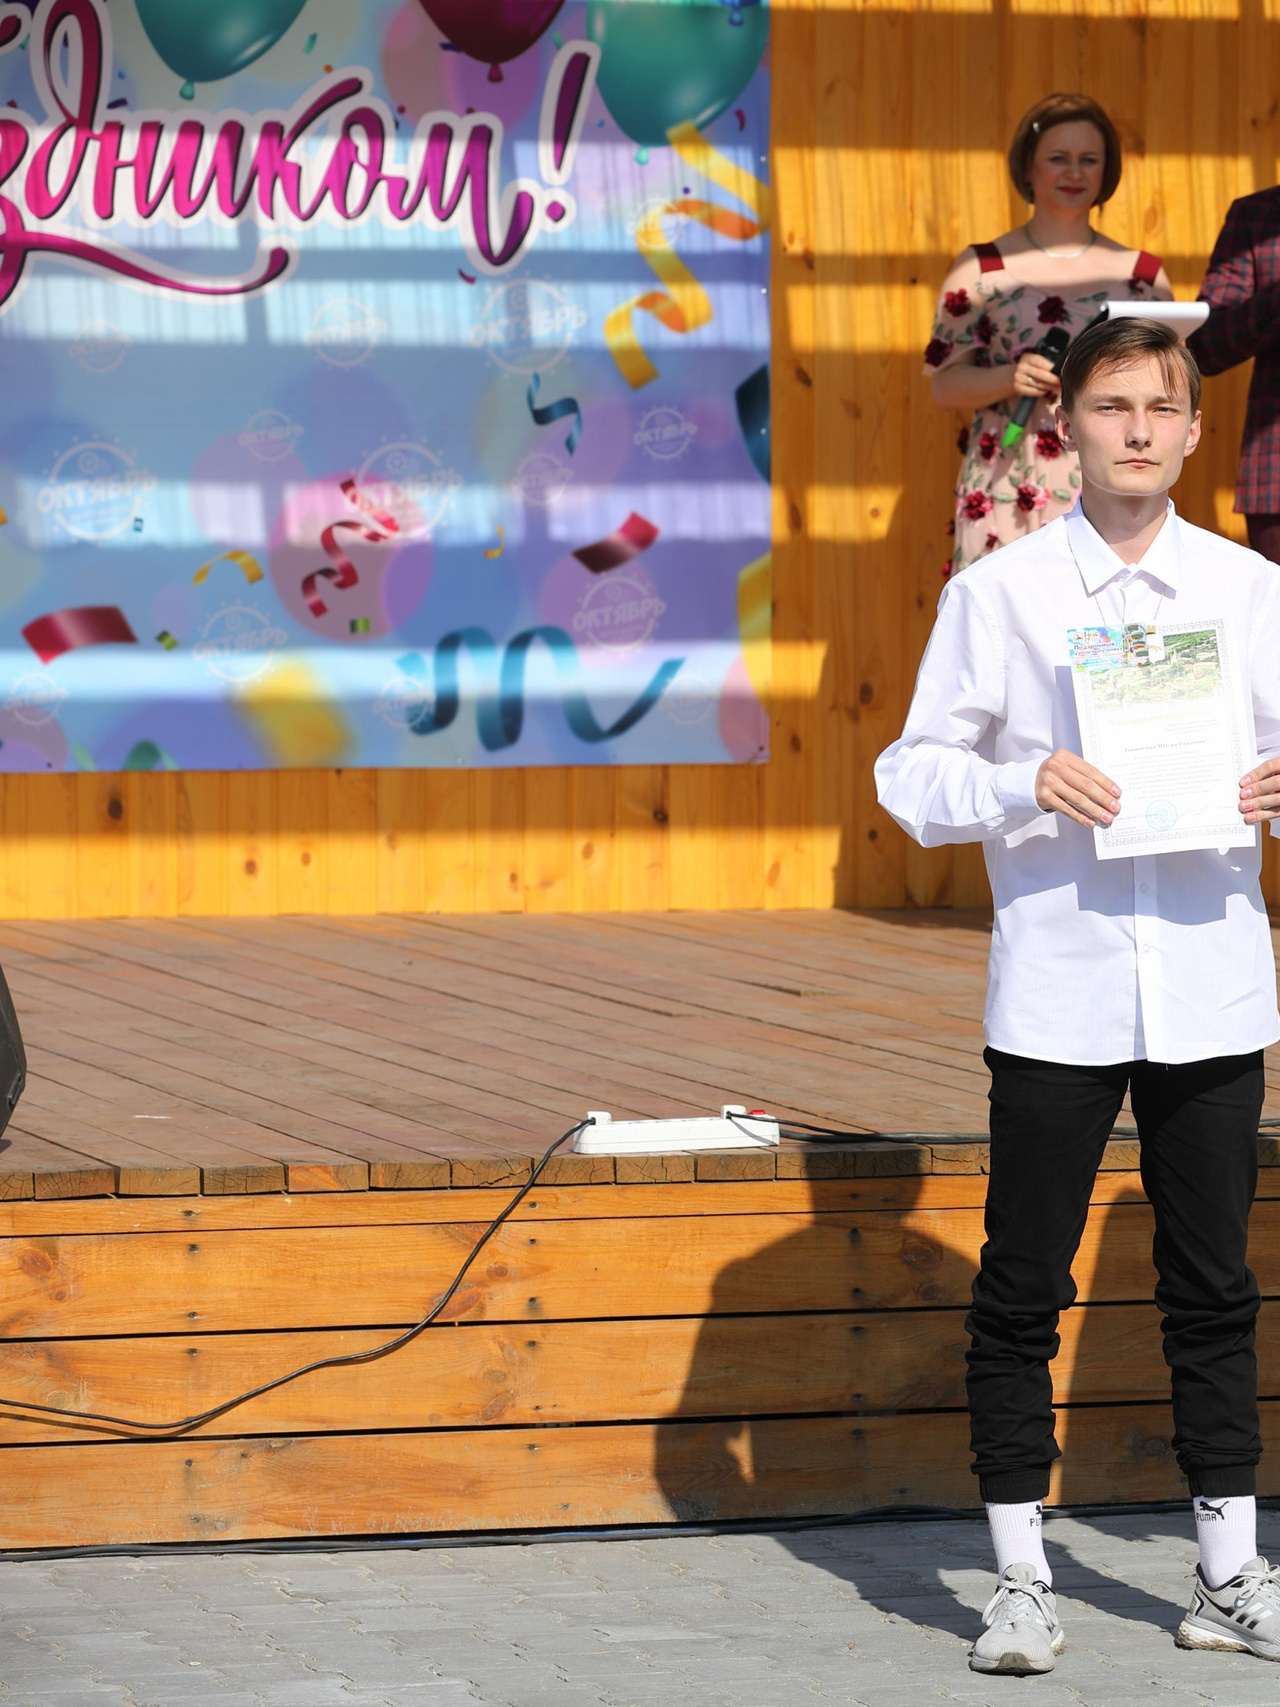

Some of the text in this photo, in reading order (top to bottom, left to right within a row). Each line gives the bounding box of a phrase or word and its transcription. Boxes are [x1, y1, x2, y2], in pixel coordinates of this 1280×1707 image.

[469, 307, 588, 347] ОКТЯБРЬ
[37, 470, 158, 513] ОКТЯБРЬ
[572, 598, 667, 631] ОКТЯБРЬ
[191, 627, 288, 661] ОКТЯБРЬ
[1196, 1512, 1217, 1522] PUMA
